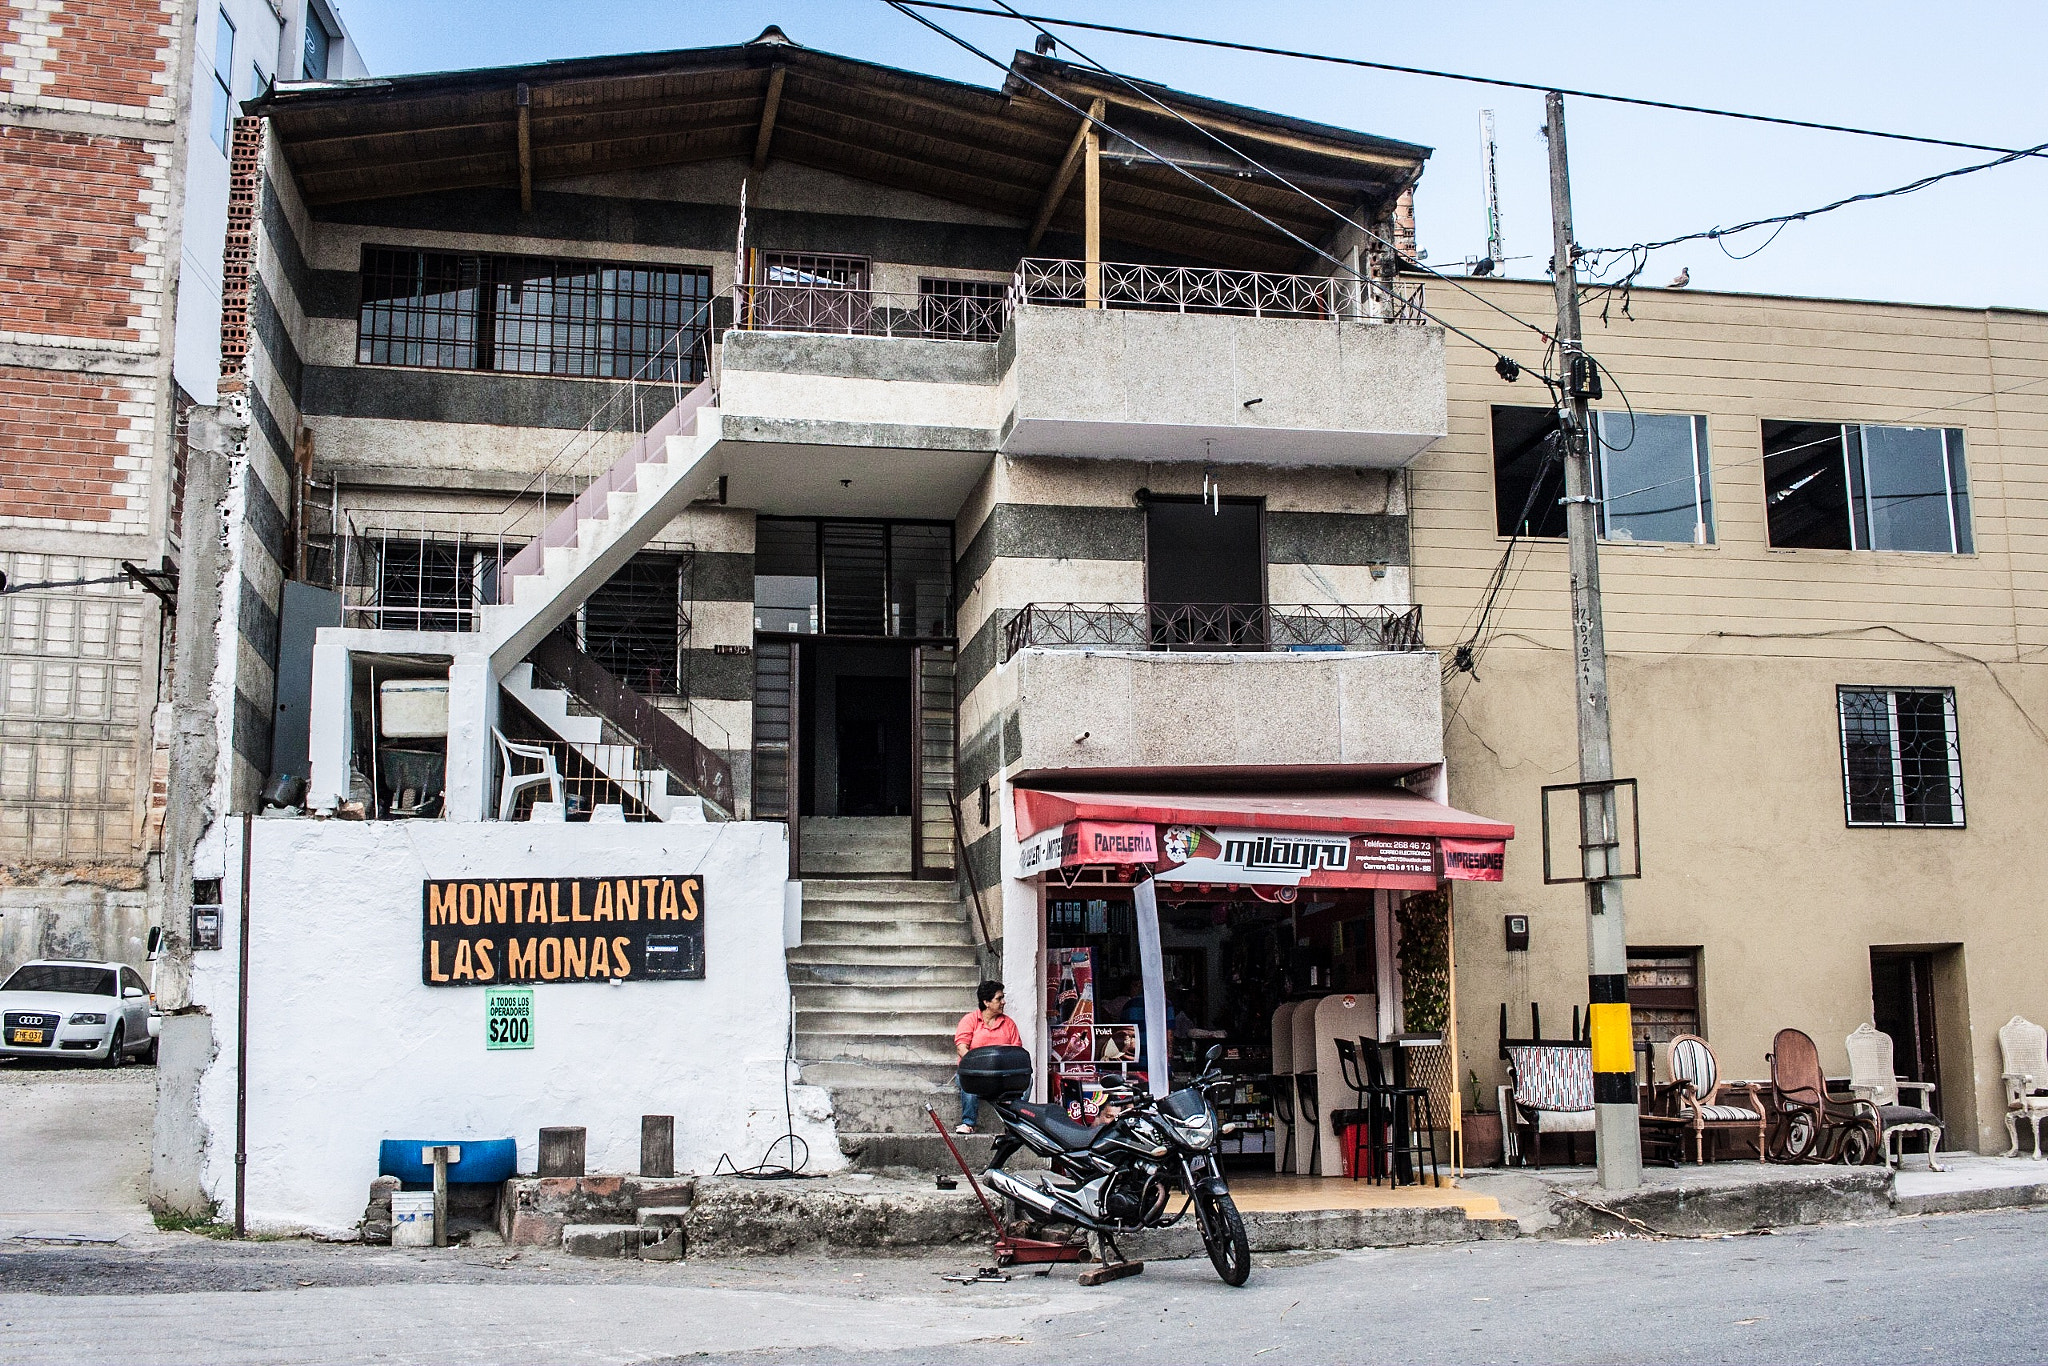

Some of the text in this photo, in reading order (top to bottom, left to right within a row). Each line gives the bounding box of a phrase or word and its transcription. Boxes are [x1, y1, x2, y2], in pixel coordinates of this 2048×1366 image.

[1094, 831, 1152, 852] PAPELERÍA
[1393, 841, 1408, 849] 268
[1409, 842, 1420, 850] 46
[1420, 842, 1431, 850] 73
[1224, 837, 1347, 870] milagro
[1446, 850, 1504, 870] IMPRESIONES
[429, 878, 699, 926] MONTALLANTAS
[430, 936, 631, 982] LAS MONAS
[490, 997, 530, 1006] A TODOS LOS
[490, 1007, 530, 1016] OPERADORES
[489, 1018, 529, 1043] $200
